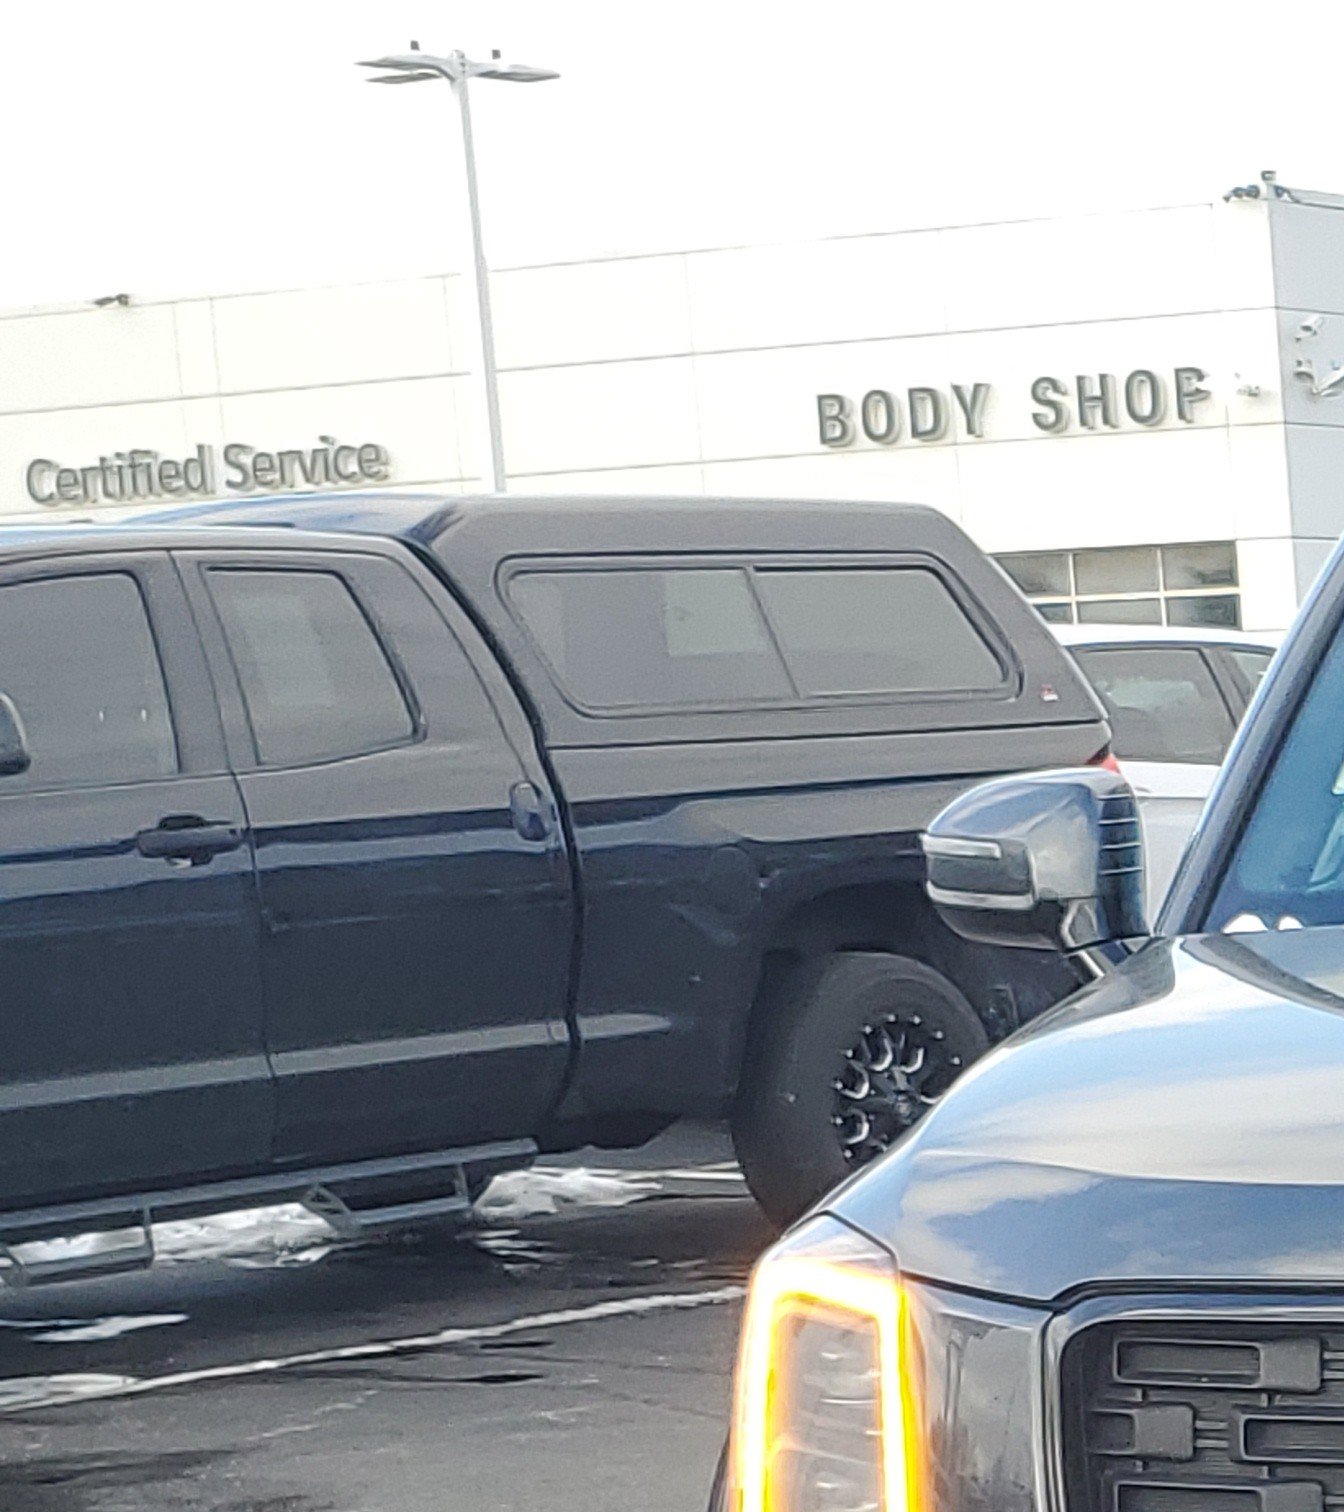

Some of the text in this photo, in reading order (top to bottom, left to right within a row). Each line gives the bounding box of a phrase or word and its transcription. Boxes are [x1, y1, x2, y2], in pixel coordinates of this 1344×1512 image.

[817, 366, 1211, 447] BODY SHOP
[26, 434, 391, 505] Certified Service
